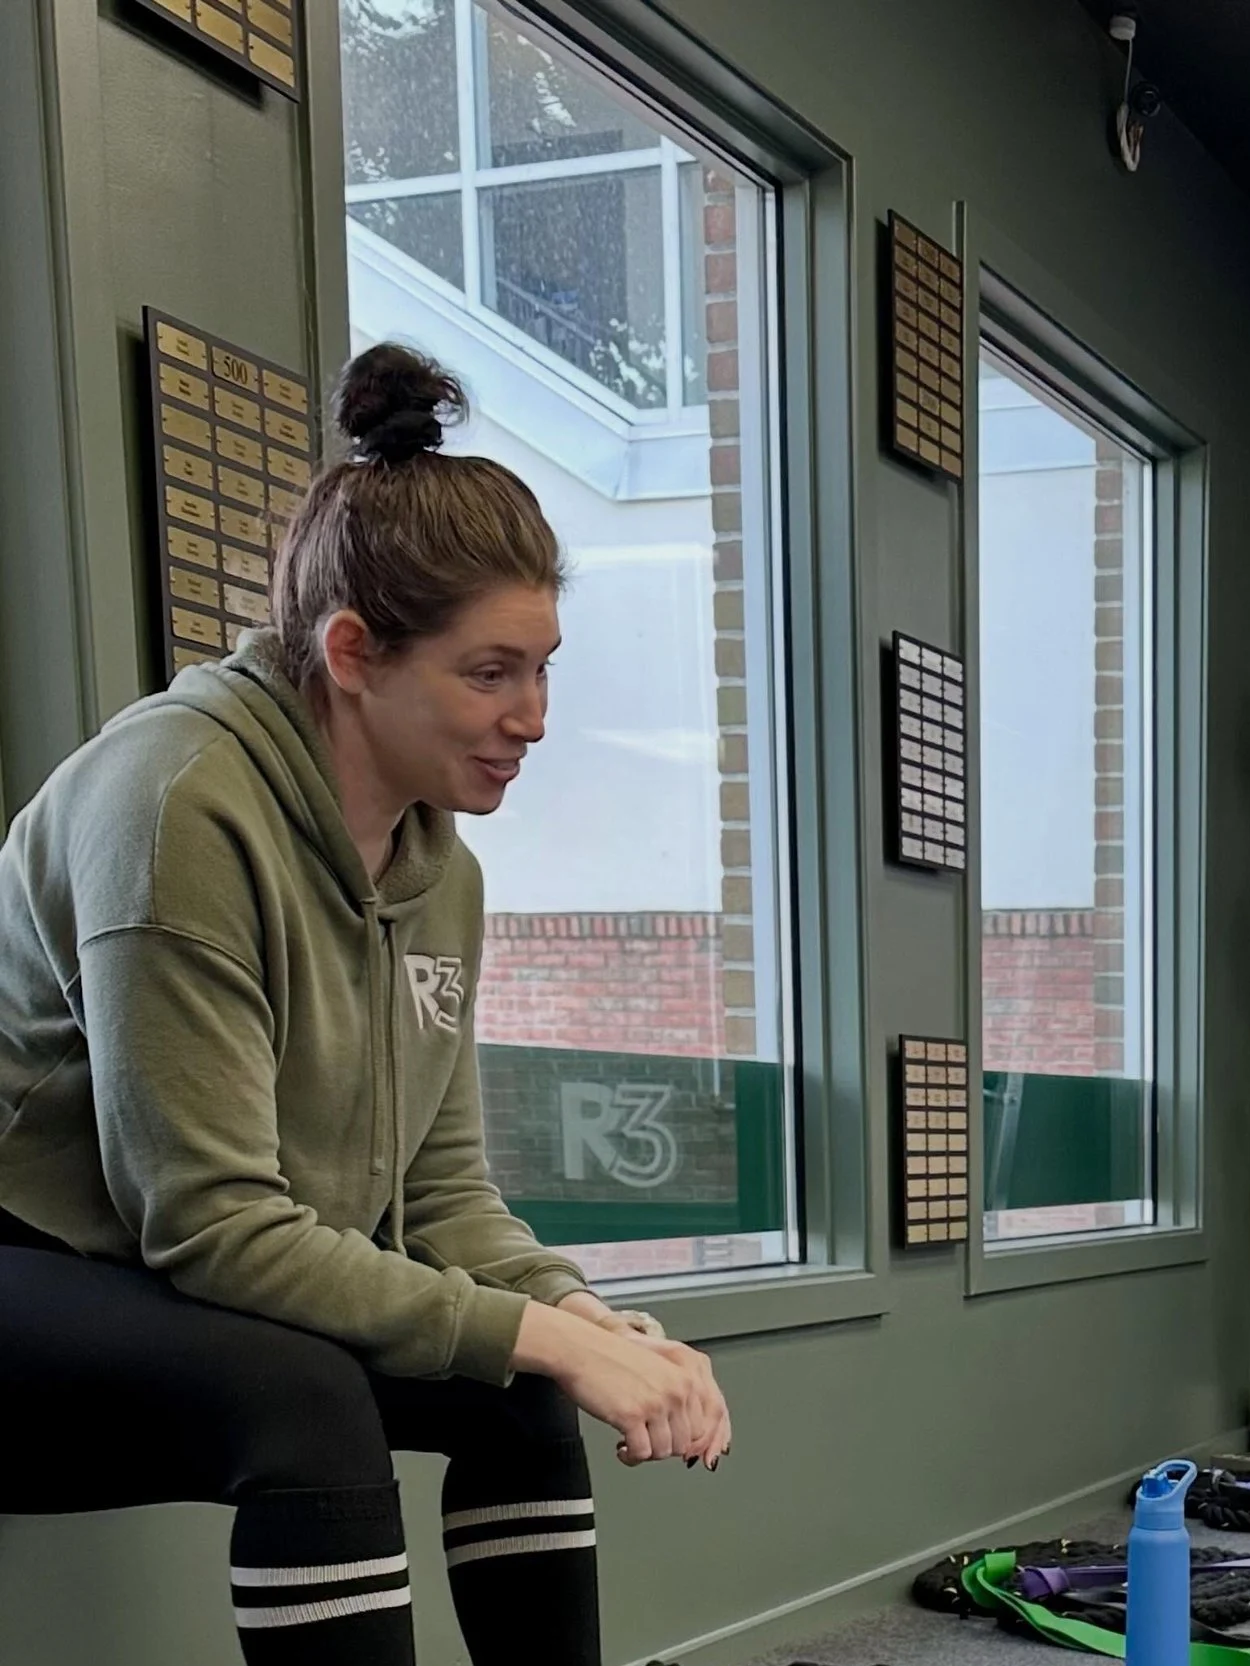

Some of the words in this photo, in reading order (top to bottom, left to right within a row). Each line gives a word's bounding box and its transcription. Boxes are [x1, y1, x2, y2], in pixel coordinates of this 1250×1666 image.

[223, 355, 248, 385] 500
[404, 954, 465, 1033] R3
[561, 1082, 677, 1188] R3
